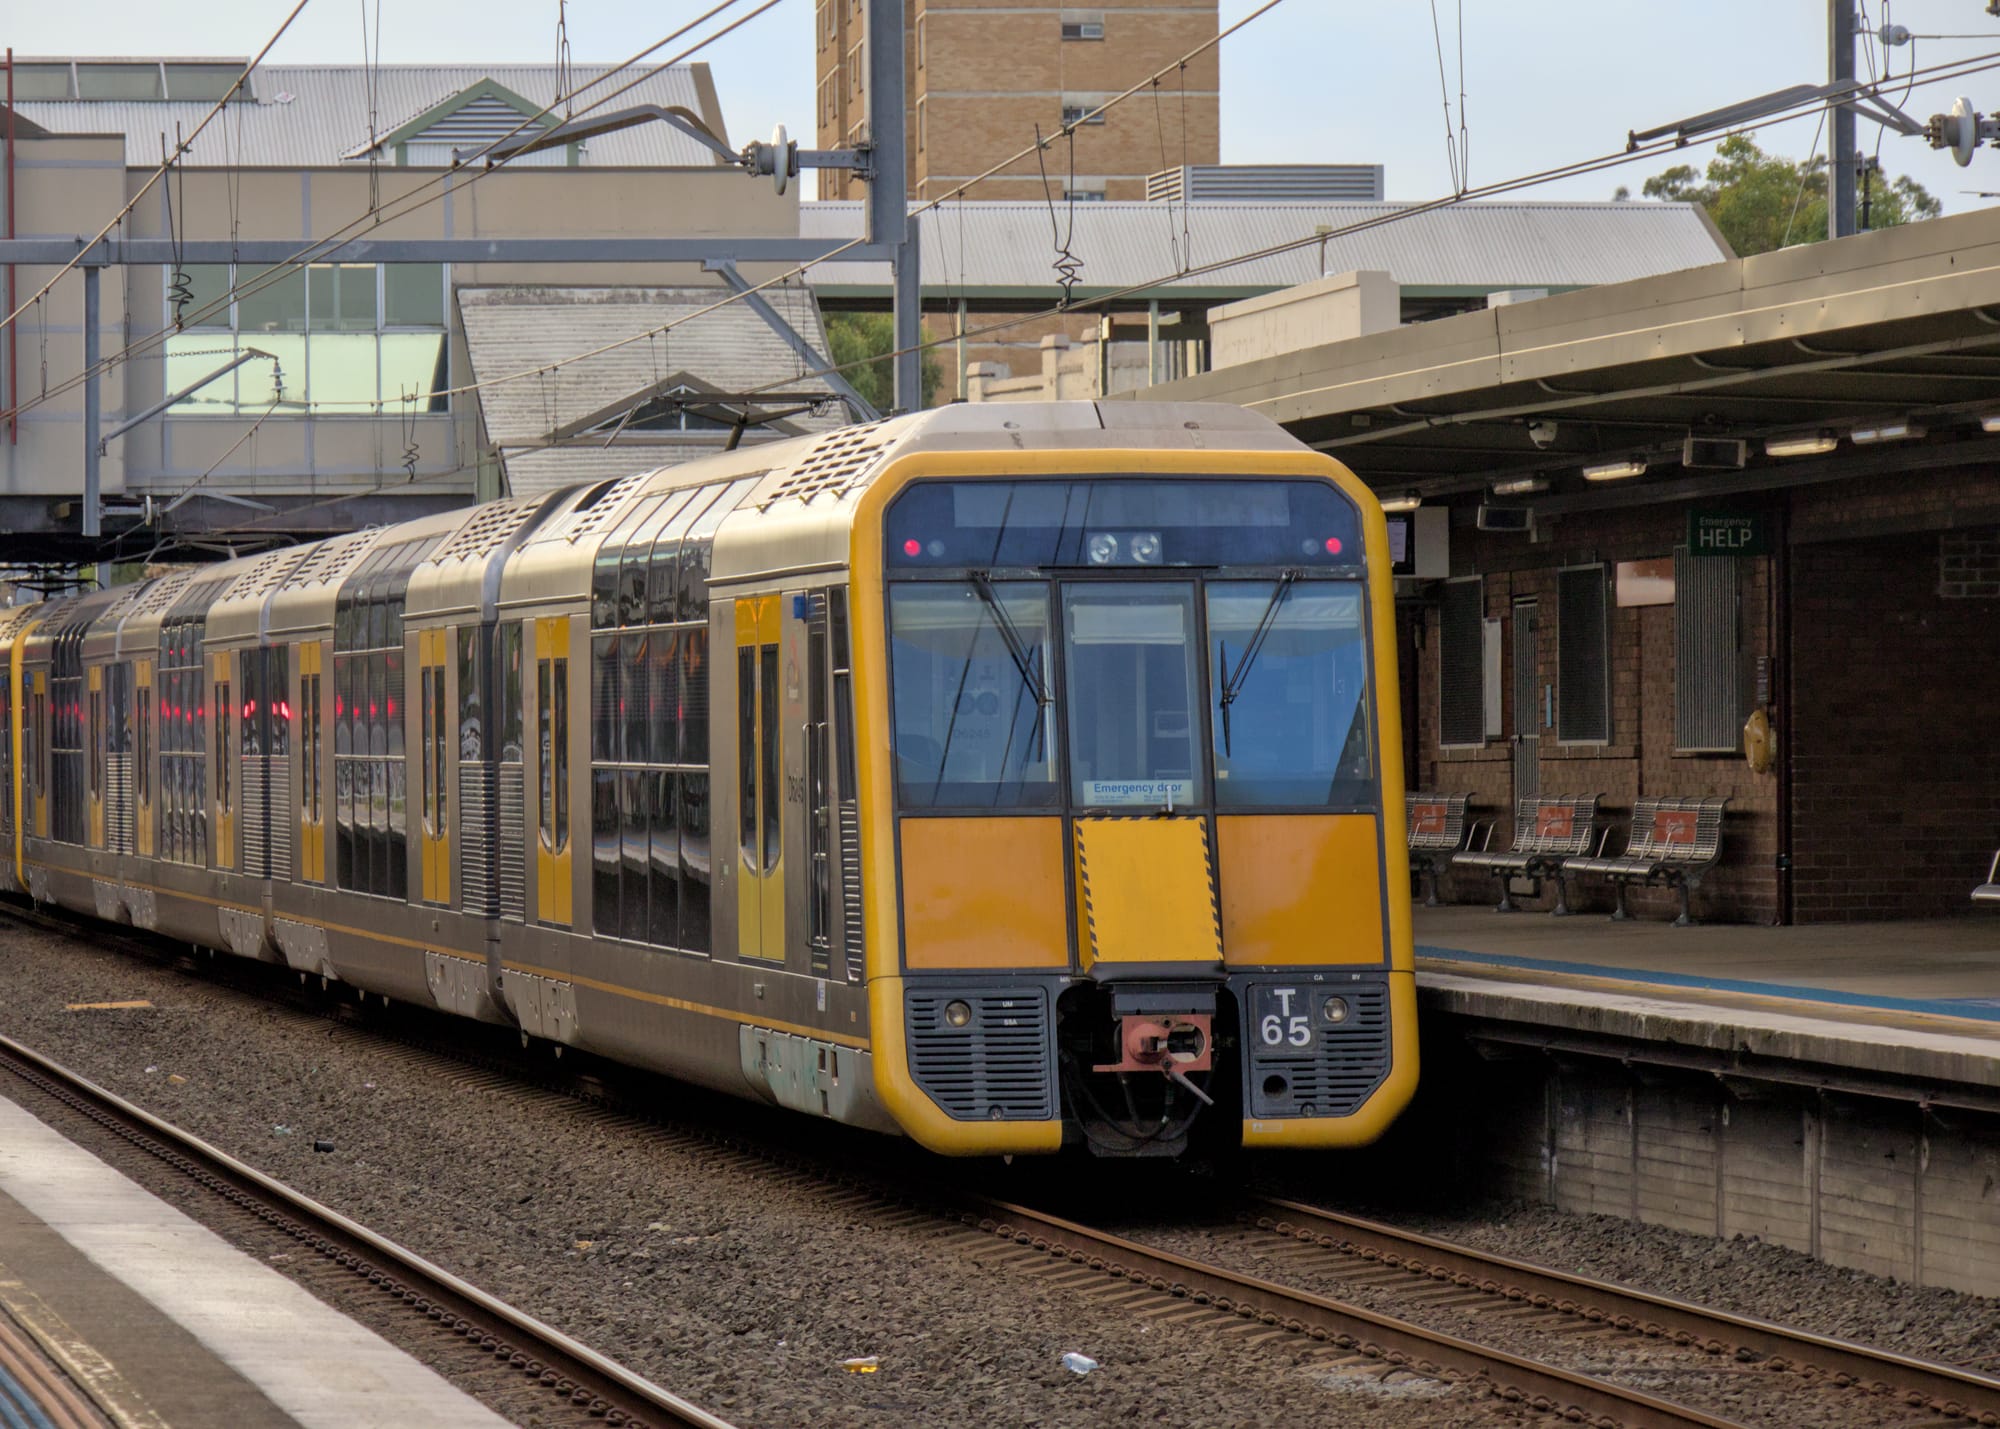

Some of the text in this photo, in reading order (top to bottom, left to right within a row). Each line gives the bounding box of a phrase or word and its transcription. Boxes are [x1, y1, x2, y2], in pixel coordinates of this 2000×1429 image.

[1699, 516, 1752, 529] Emergency
[1699, 528, 1752, 548] HELP
[1093, 783, 1154, 794] Emergency
[1274, 988, 1296, 1016] T
[1261, 1015, 1311, 1046] 65
